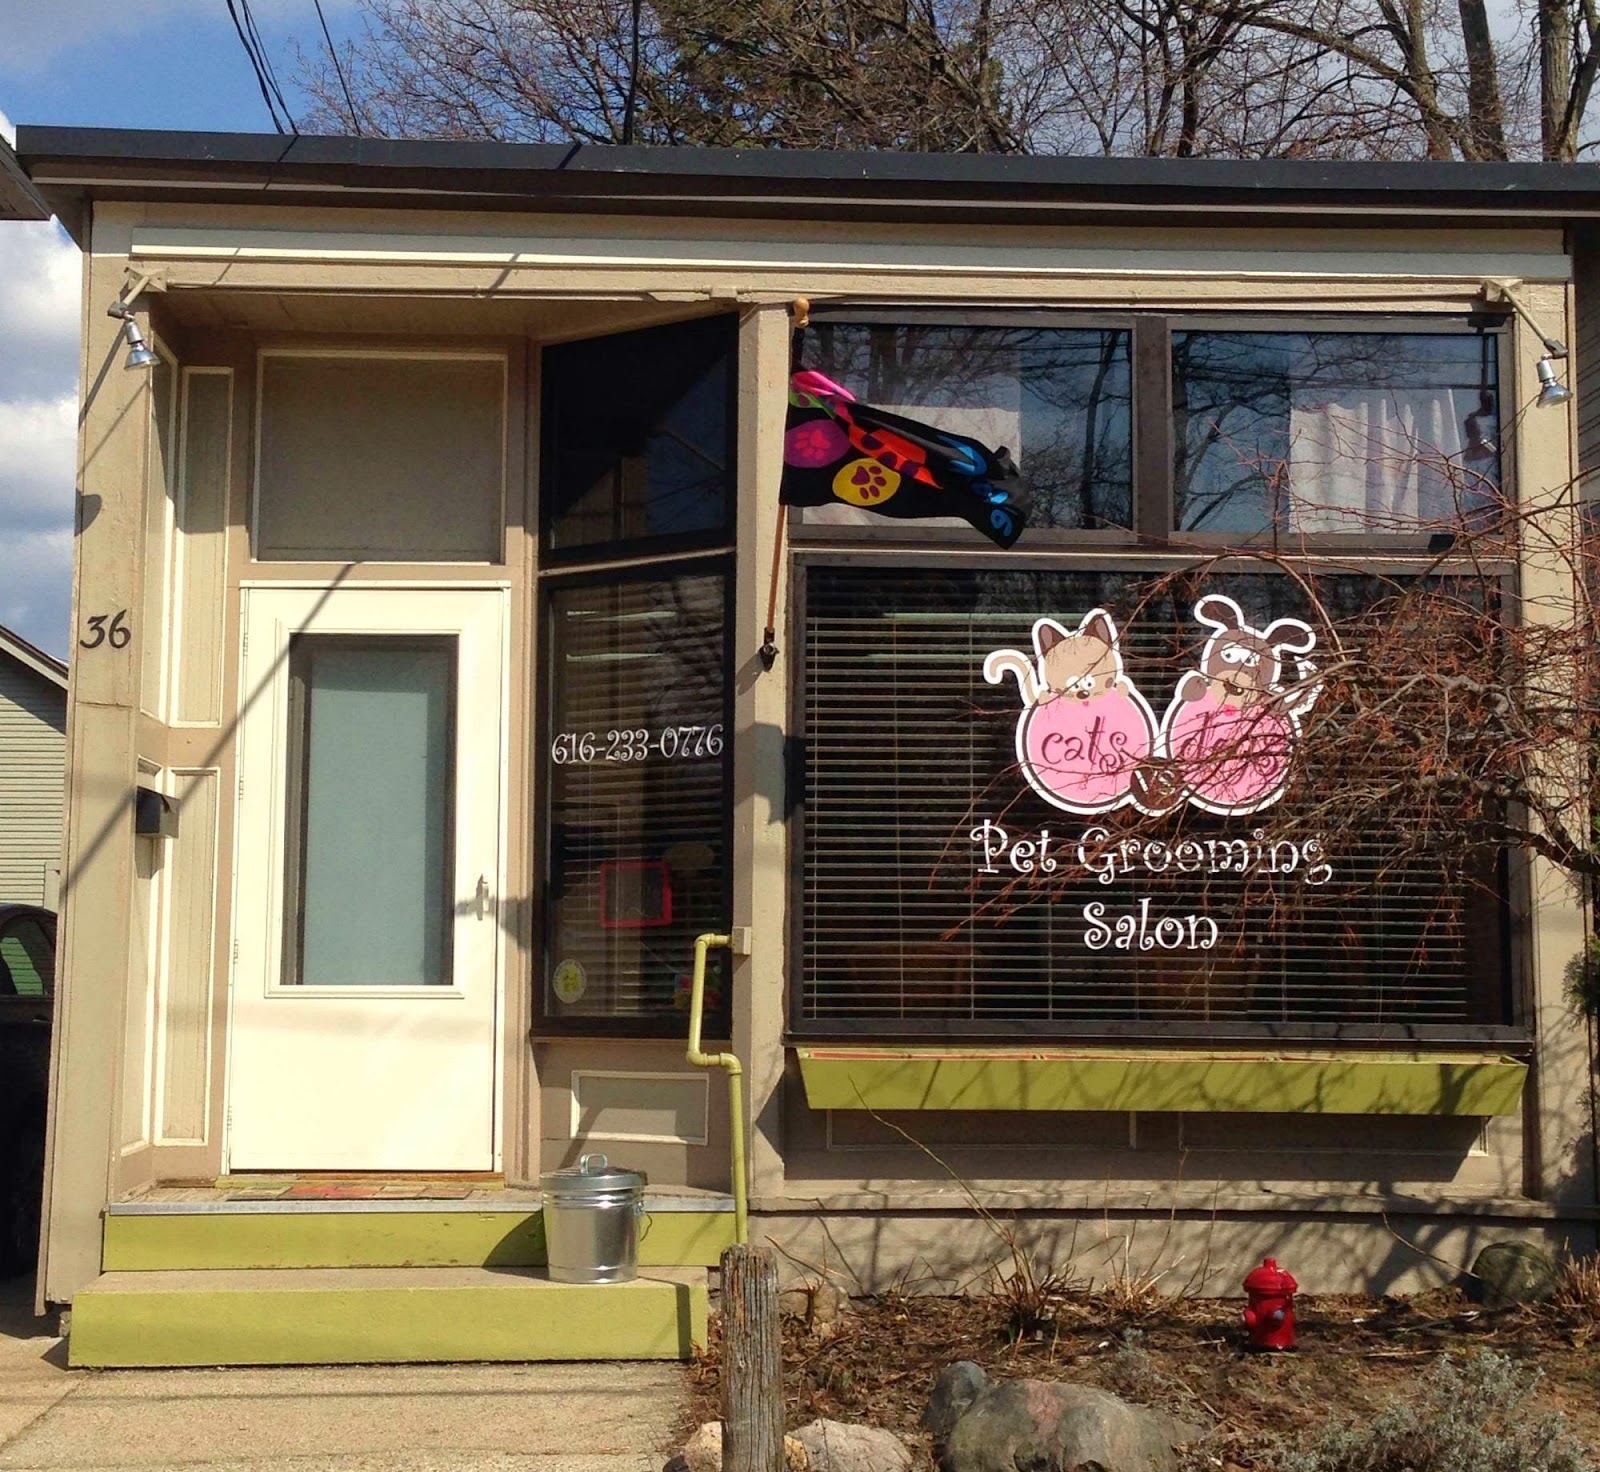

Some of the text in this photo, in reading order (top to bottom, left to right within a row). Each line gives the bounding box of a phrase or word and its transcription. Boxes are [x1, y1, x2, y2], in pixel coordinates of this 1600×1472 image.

[80, 608, 131, 648] 36
[551, 723, 724, 764] 616-233-0776
[1041, 715, 1127, 775] cats
[970, 819, 1333, 885] Pet Grooming
[1083, 897, 1219, 951] Salon
